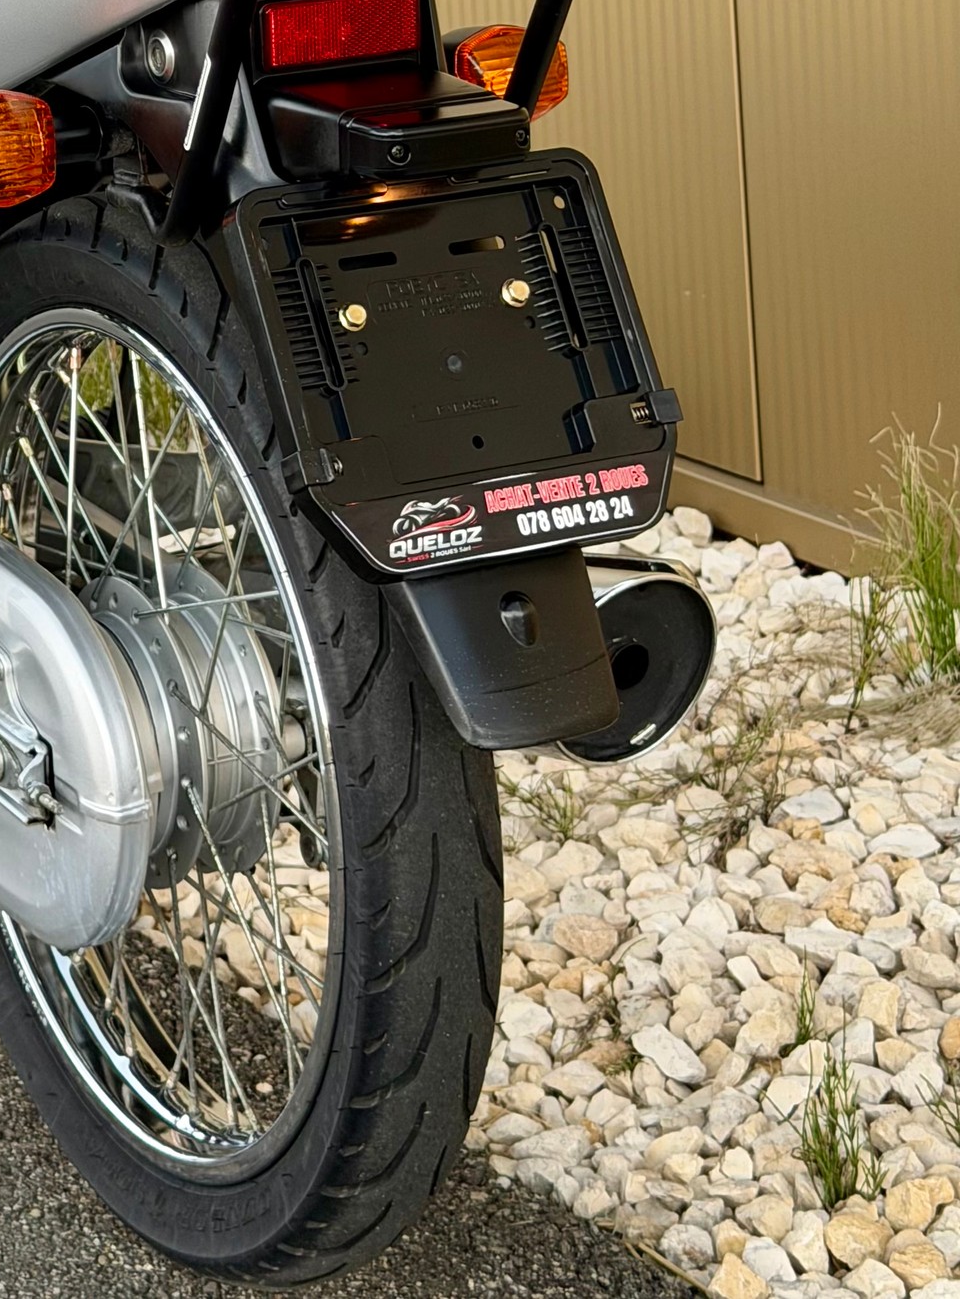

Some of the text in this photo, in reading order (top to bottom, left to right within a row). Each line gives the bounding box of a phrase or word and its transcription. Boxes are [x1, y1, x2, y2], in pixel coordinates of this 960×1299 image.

[484, 464, 649, 513] ACHAT-VENTE 2 ROUES
[517, 495, 634, 536] 078 604 28 24
[389, 526, 483, 558] QUELOZ
